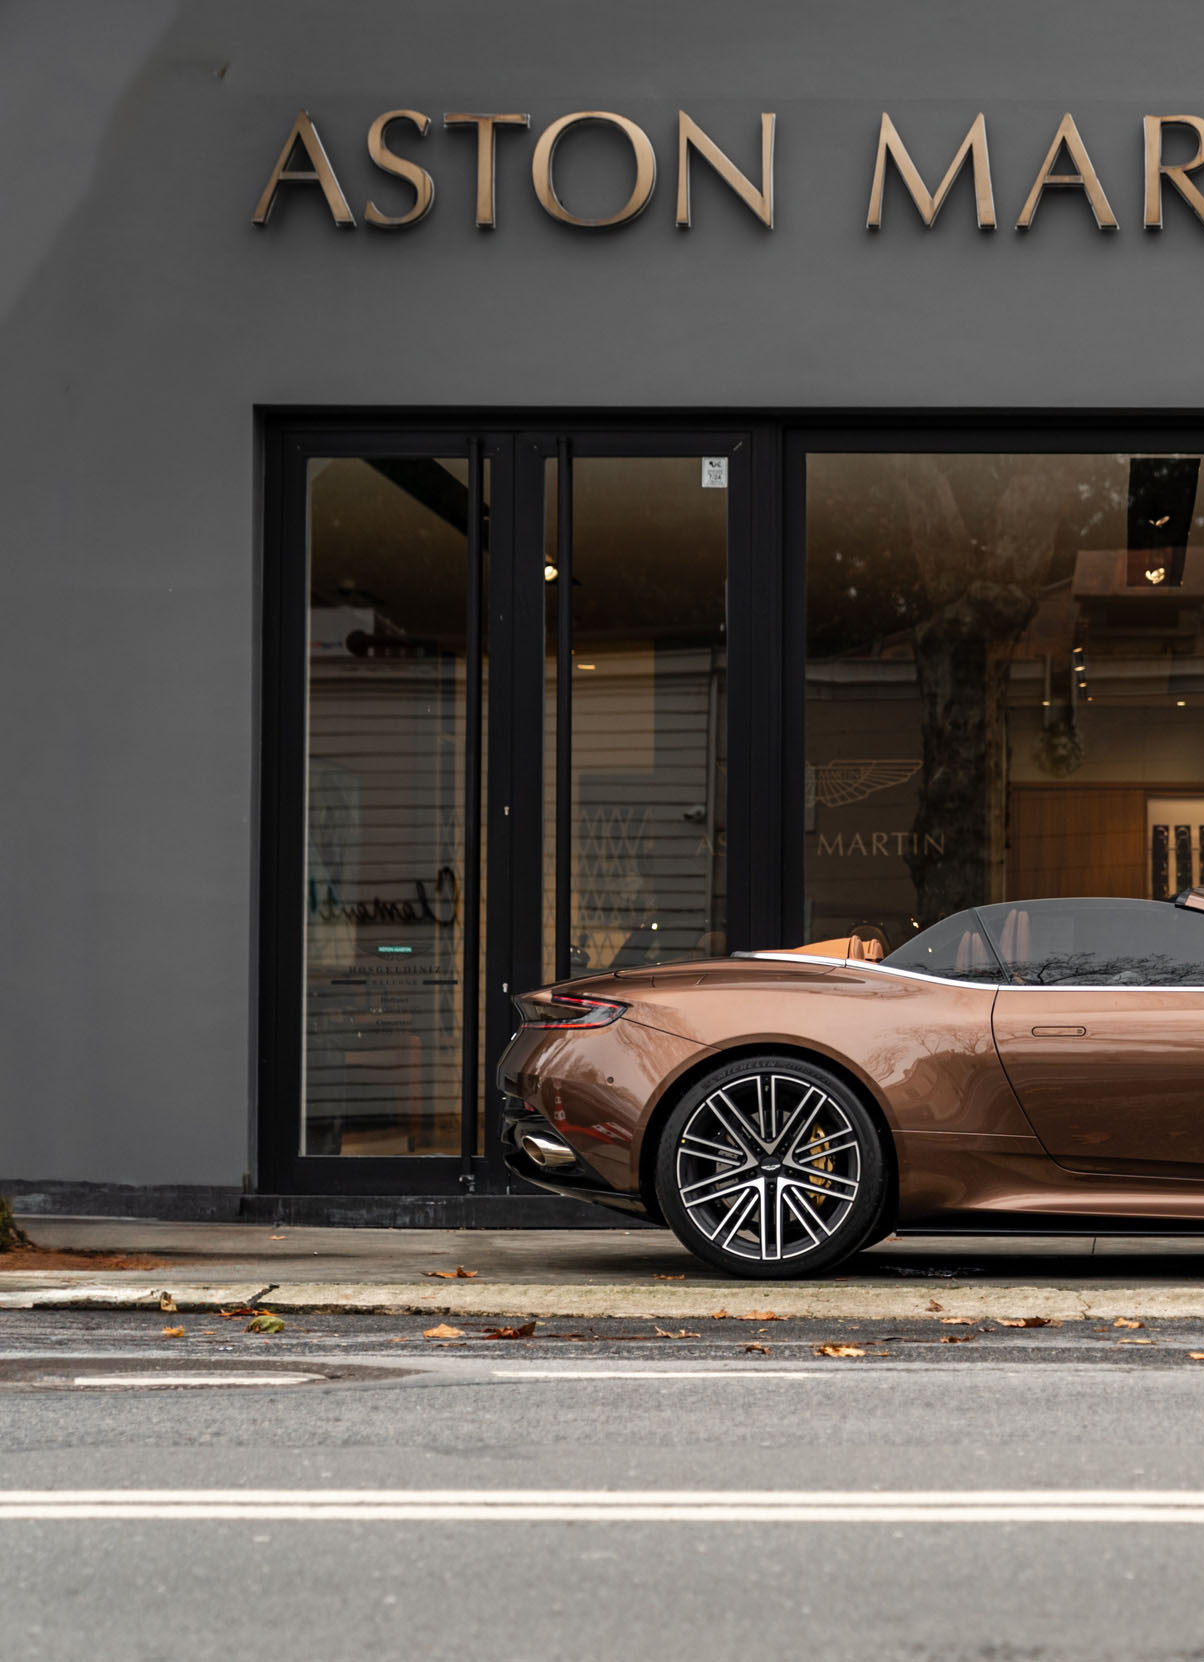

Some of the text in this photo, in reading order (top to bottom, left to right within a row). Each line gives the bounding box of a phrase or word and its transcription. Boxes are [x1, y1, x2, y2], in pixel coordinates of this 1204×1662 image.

[251, 109, 775, 229] ASTON
[816, 832, 946, 857] MARTIN
[716, 1060, 778, 1080] MICHELIN
